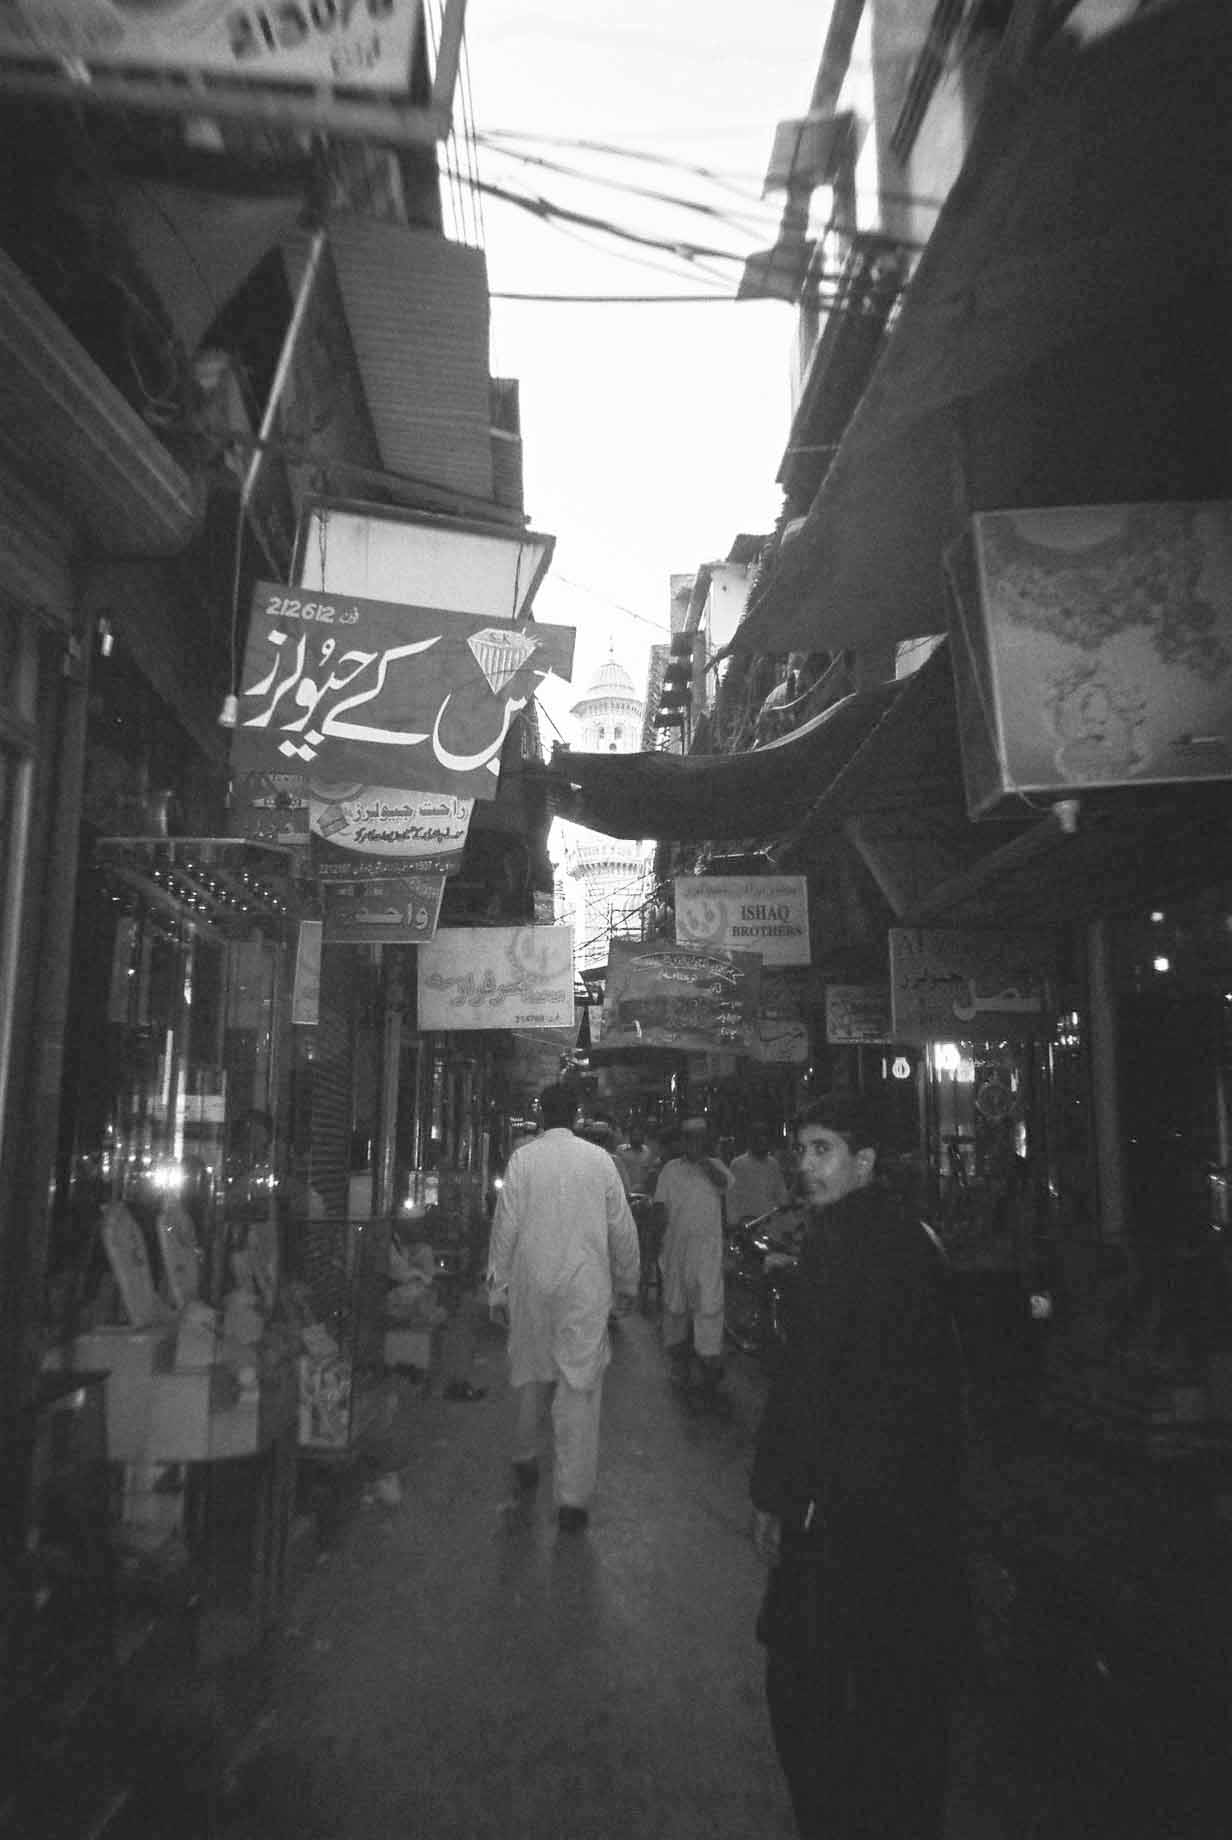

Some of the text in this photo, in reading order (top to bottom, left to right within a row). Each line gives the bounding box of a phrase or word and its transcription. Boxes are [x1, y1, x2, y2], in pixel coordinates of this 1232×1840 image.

[265, 596, 336, 624] 212612
[322, 635, 444, 746] کے
[740, 904, 792, 923] ISHAQ
[731, 925, 803, 937] BROTHERS
